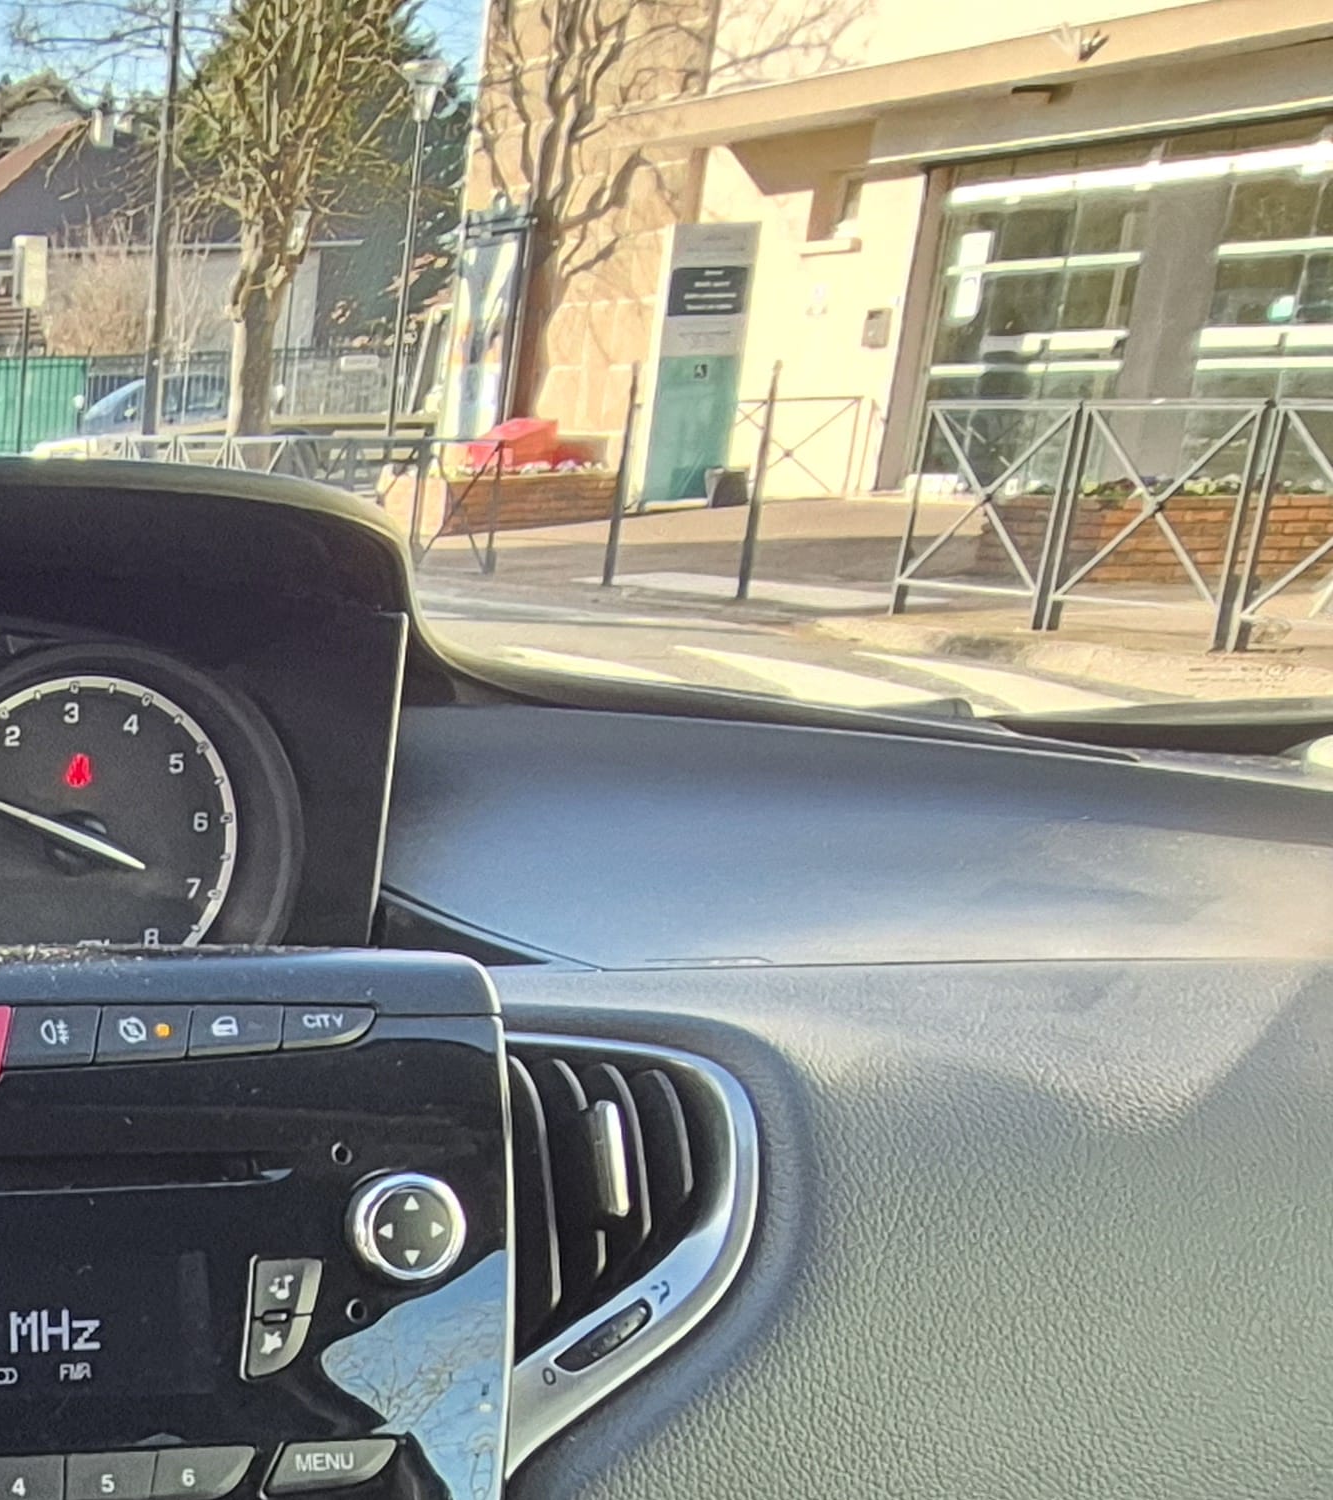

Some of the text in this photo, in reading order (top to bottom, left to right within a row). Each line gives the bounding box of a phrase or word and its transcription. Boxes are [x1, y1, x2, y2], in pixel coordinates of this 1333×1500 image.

[63, 702, 80, 724] 3
[122, 713, 140, 735] 4
[4, 725, 22, 748] 2
[168, 752, 185, 774] 5
[192, 811, 210, 833] 6
[186, 878, 202, 900] 7
[143, 927, 160, 947] 8
[301, 1012, 344, 1030] CITY
[9, 1308, 102, 1354] MHz
[294, 1451, 355, 1473] MENU
[10, 1476, 26, 1497] 4
[100, 1473, 116, 1494] 5
[181, 1467, 196, 1488] 6
